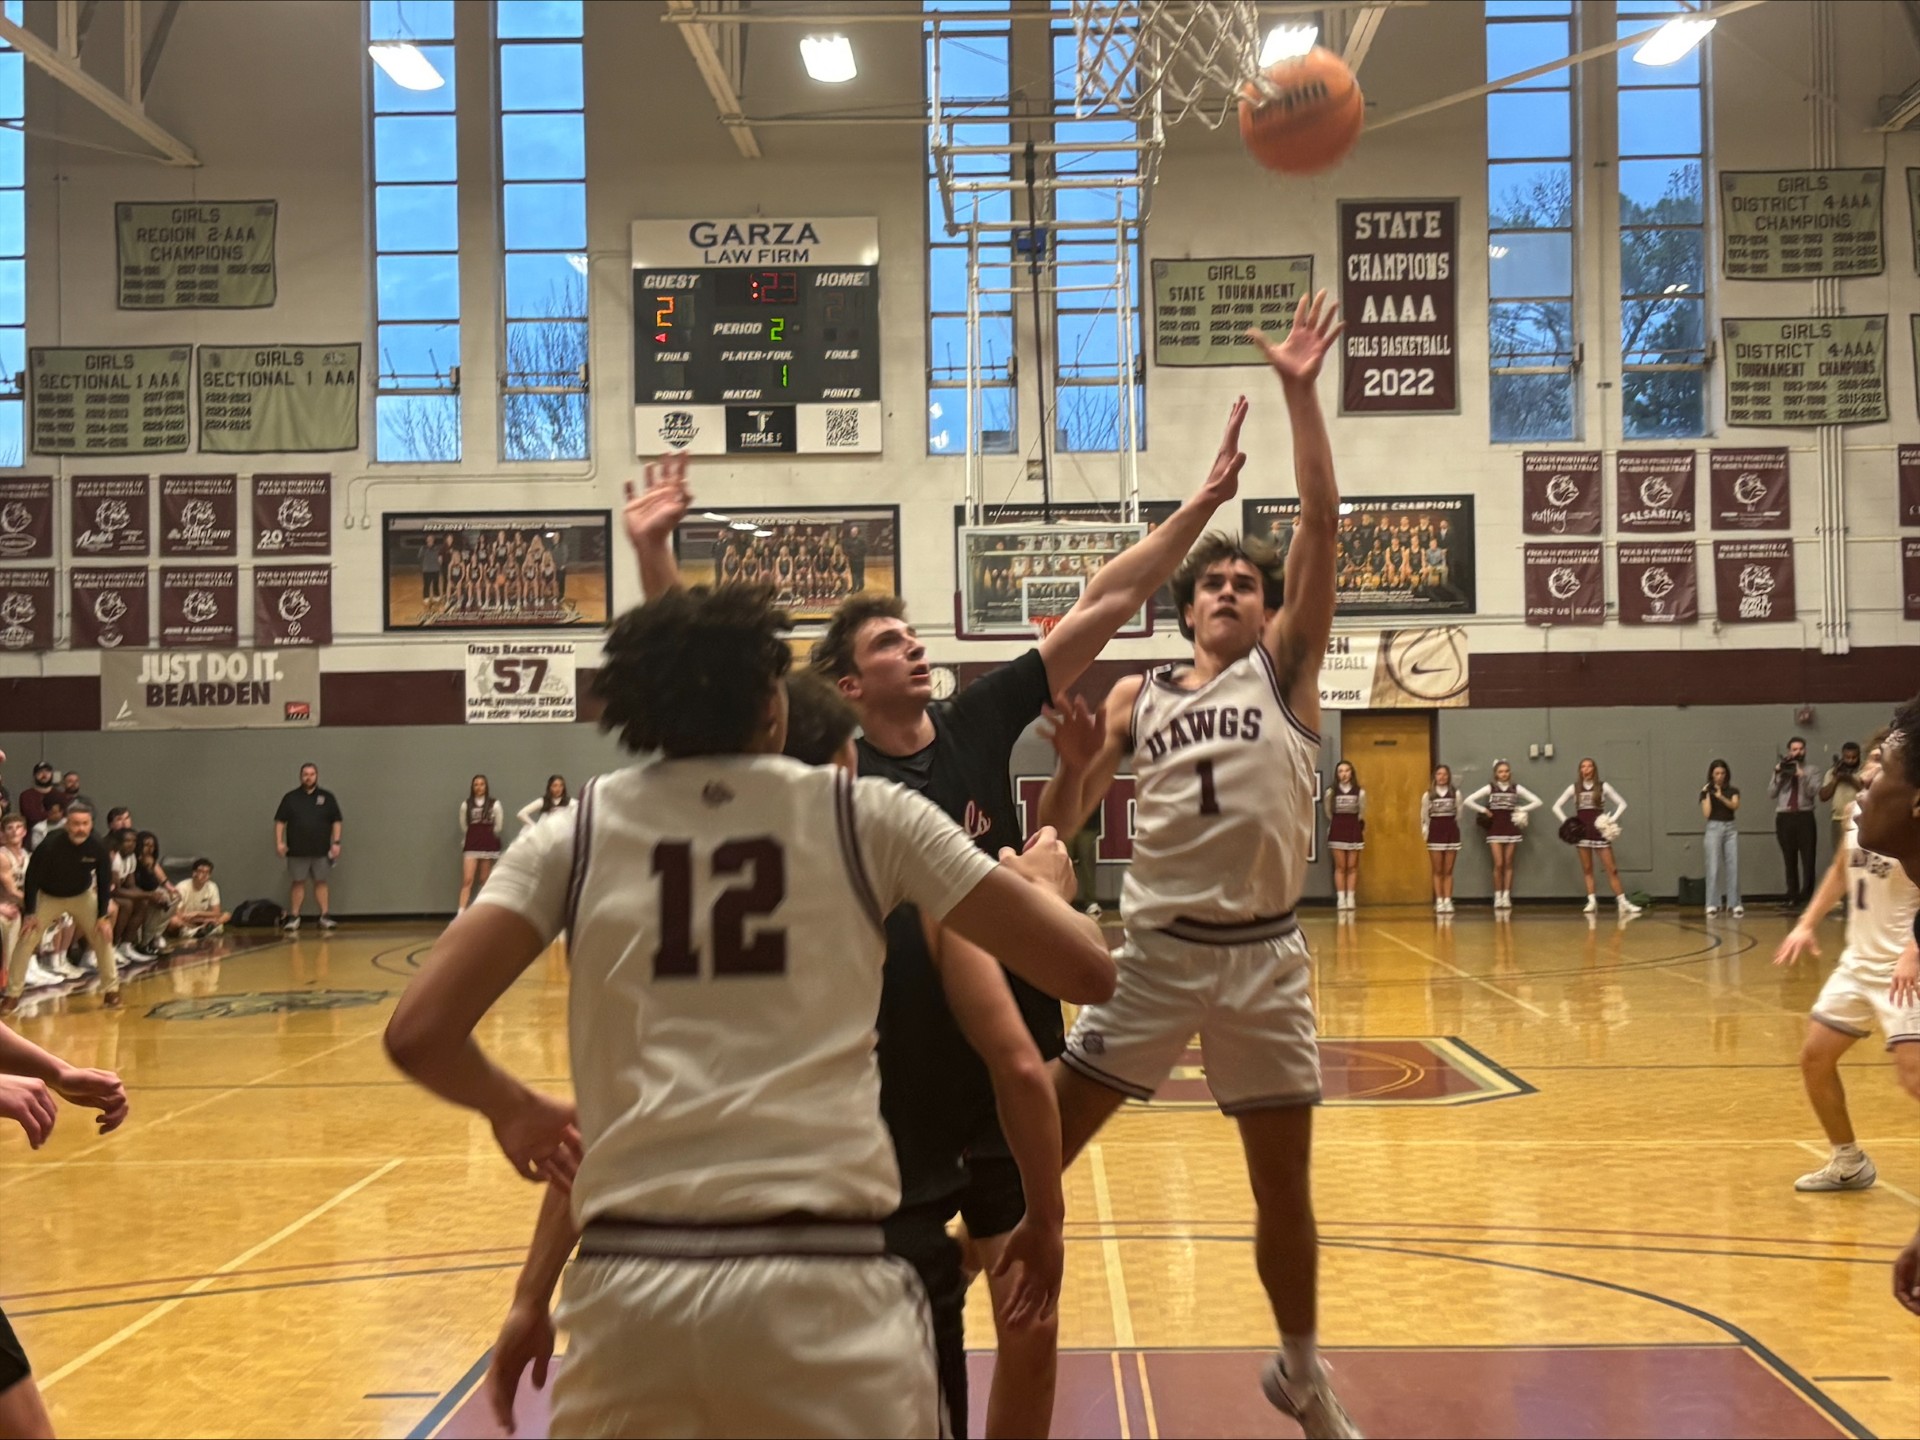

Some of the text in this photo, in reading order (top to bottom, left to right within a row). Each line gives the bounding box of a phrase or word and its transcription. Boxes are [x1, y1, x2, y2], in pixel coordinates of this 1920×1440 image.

[1778, 176, 1829, 193] GIRLS
[1731, 196, 1809, 212] DISTRICT
[172, 208, 220, 224] GIRLS
[1755, 213, 1852, 231] CHAMPIONS
[1355, 211, 1442, 240] STATE
[136, 227, 196, 243] REGION
[689, 222, 820, 248] GARZA
[150, 245, 243, 262] CHAMPIONS
[704, 249, 809, 265] LAW FIRM
[1208, 265, 1256, 281] GIRLS
[1348, 252, 1449, 282] CHAMPIONS
[643, 274, 700, 289] GUEST
[815, 272, 865, 287] HOME
[1169, 283, 1295, 301] STATE TOURNAMENT
[1361, 295, 1436, 323] AAAA
[713, 318, 785, 341] PERIOD 2
[1781, 323, 1832, 340] GIRLS
[824, 350, 860, 359] FOULS
[1348, 335, 1451, 358] GIRLS BASKETBALL
[1736, 343, 1815, 359] DISTRICT
[85, 354, 134, 370] GIRLS
[255, 351, 304, 367] GIRLS
[656, 352, 690, 361] FOULS
[781, 364, 788, 387] 1
[1736, 360, 1876, 377] TOURNAMENT CHAMPIONS
[39, 372, 180, 390] SECTIONAL 1 AAA
[202, 370, 355, 388] SECTIONAL 1 AAA
[1364, 368, 1435, 397] 2022
[654, 390, 694, 400] POINTS
[723, 390, 761, 399] MATCH
[822, 388, 861, 398] POINTS
[1256, 501, 1461, 514] TENNES STATE CHAMPIONS
[1528, 607, 1554, 615] FIRST
[503, 644, 574, 655] BASKETBALL
[137, 651, 284, 683] JUST DO IT.
[493, 659, 548, 694] 57
[146, 682, 270, 707] BEARDEN
[1331, 690, 1361, 701] PRIDE
[1196, 760, 1220, 815] 1
[653, 835, 787, 978] 12
